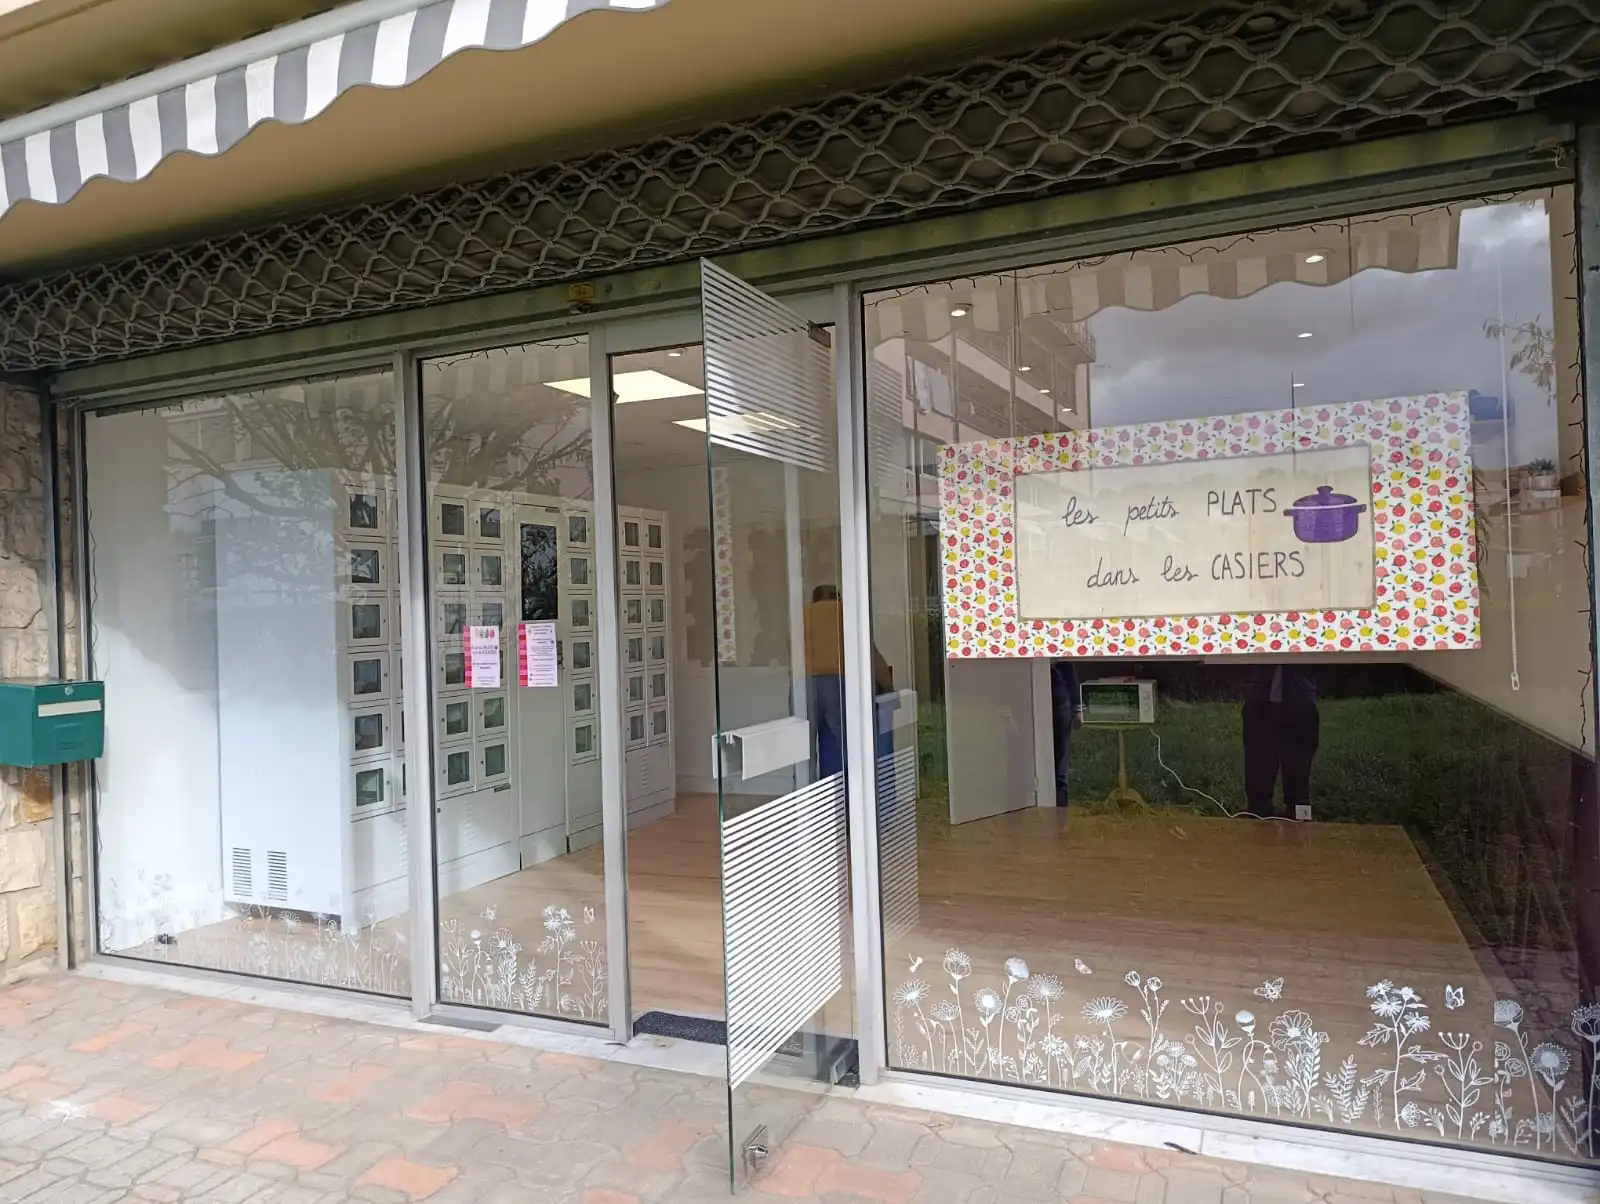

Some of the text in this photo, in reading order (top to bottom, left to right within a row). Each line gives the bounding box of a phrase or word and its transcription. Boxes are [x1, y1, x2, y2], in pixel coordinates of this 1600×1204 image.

[1062, 488, 1277, 536] les petits PLATS
[1087, 551, 1305, 588] dans les CASIERS
